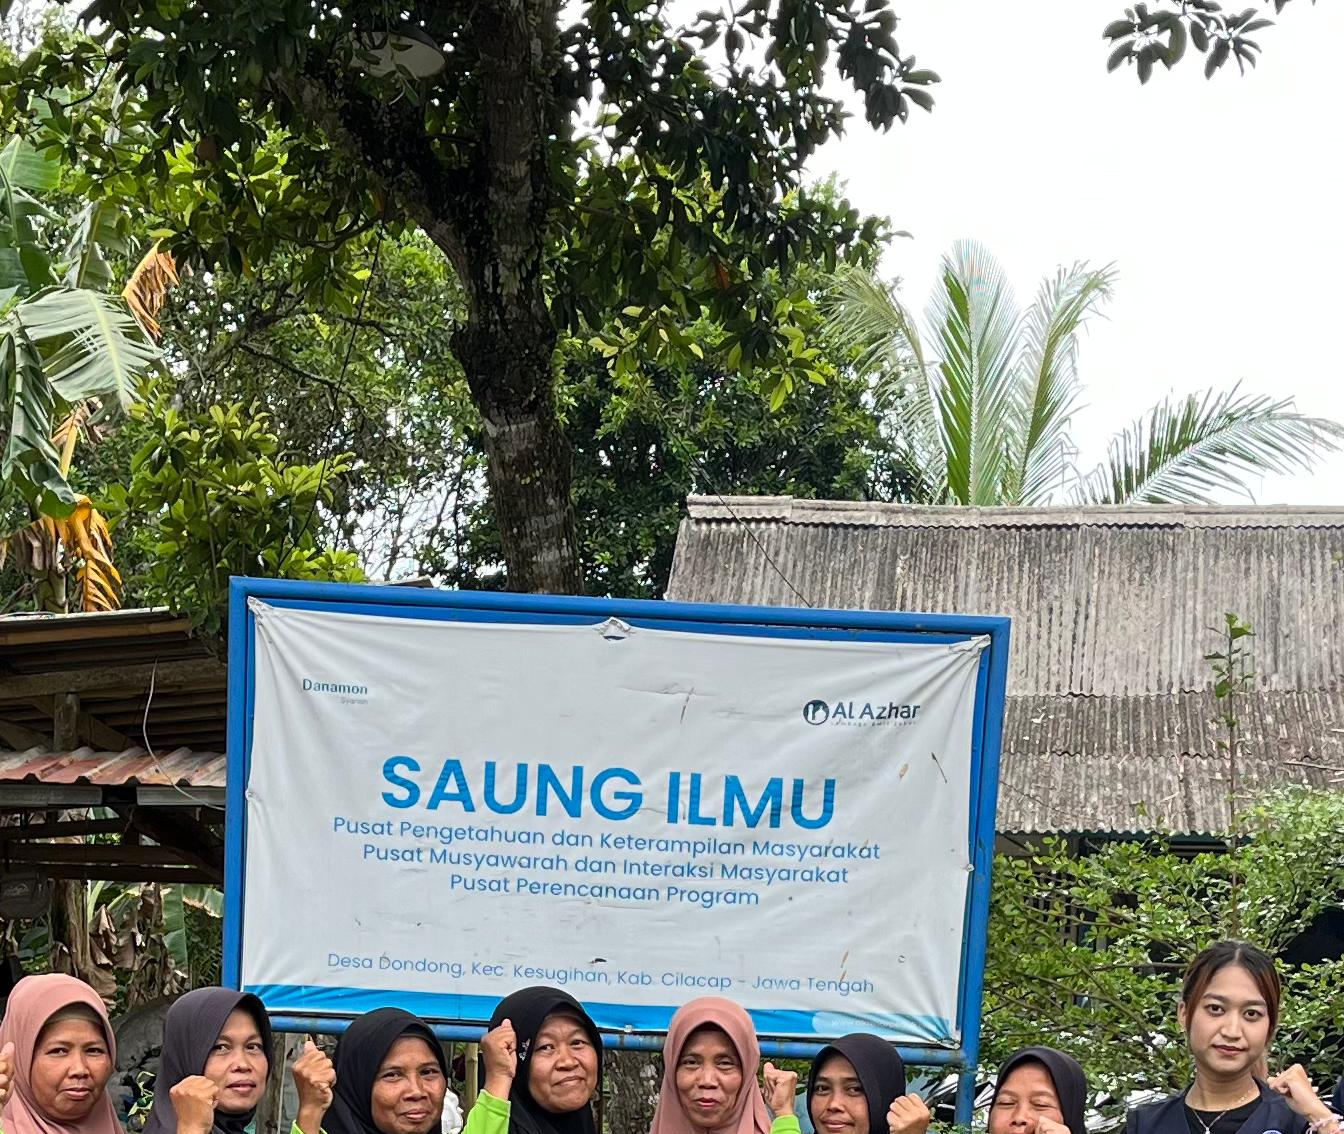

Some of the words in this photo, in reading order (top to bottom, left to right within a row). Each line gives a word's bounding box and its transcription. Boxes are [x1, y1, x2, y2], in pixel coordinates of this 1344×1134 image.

[302, 678, 368, 695] Danamon
[832, 701, 854, 719] Al
[858, 701, 921, 720] Azhar
[381, 755, 644, 821] SAUNG
[666, 770, 837, 830] ILMU
[333, 816, 394, 836] Pusat
[399, 820, 545, 845] Pengetahuan
[551, 829, 594, 848] dan
[600, 832, 746, 858] Keterampilan
[752, 838, 881, 863] Masyarakat
[363, 844, 424, 864] Pusat
[429, 847, 568, 872] Musyawarah
[574, 856, 616, 875] dan
[623, 858, 715, 879] Interaksi
[721, 863, 849, 886] Masyarakat
[450, 873, 511, 893] Pusat
[516, 877, 660, 902] Perencanaan
[666, 885, 760, 909] Program
[327, 953, 373, 970] Desa
[379, 955, 466, 978] Dondong,
[513, 964, 612, 986] Kesugihan,
[661, 972, 732, 991] Cilacap
[752, 975, 801, 990] Jawa
[807, 976, 875, 997] Tengah
